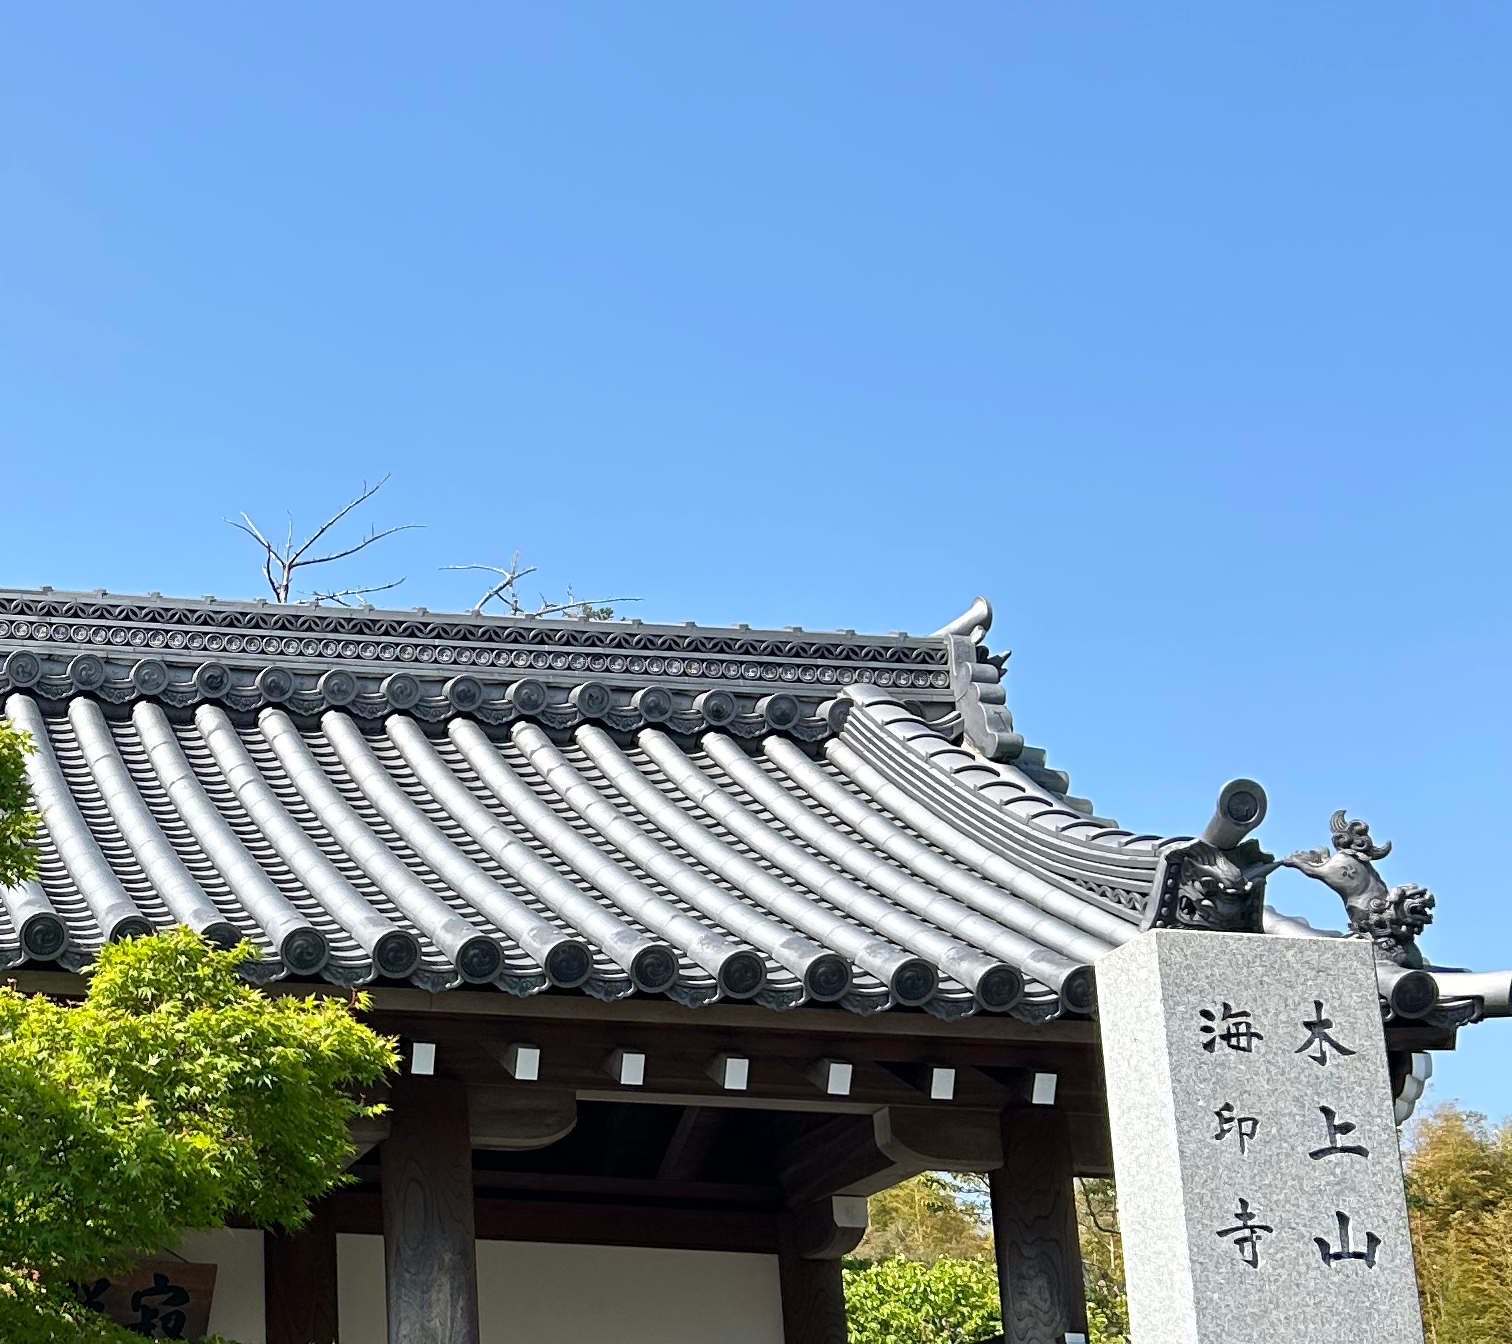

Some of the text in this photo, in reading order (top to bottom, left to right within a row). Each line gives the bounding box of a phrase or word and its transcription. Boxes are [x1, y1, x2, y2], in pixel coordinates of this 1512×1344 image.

[1199, 1000, 1274, 1270] 海印寺
[1294, 999, 1382, 1268] 木上山
